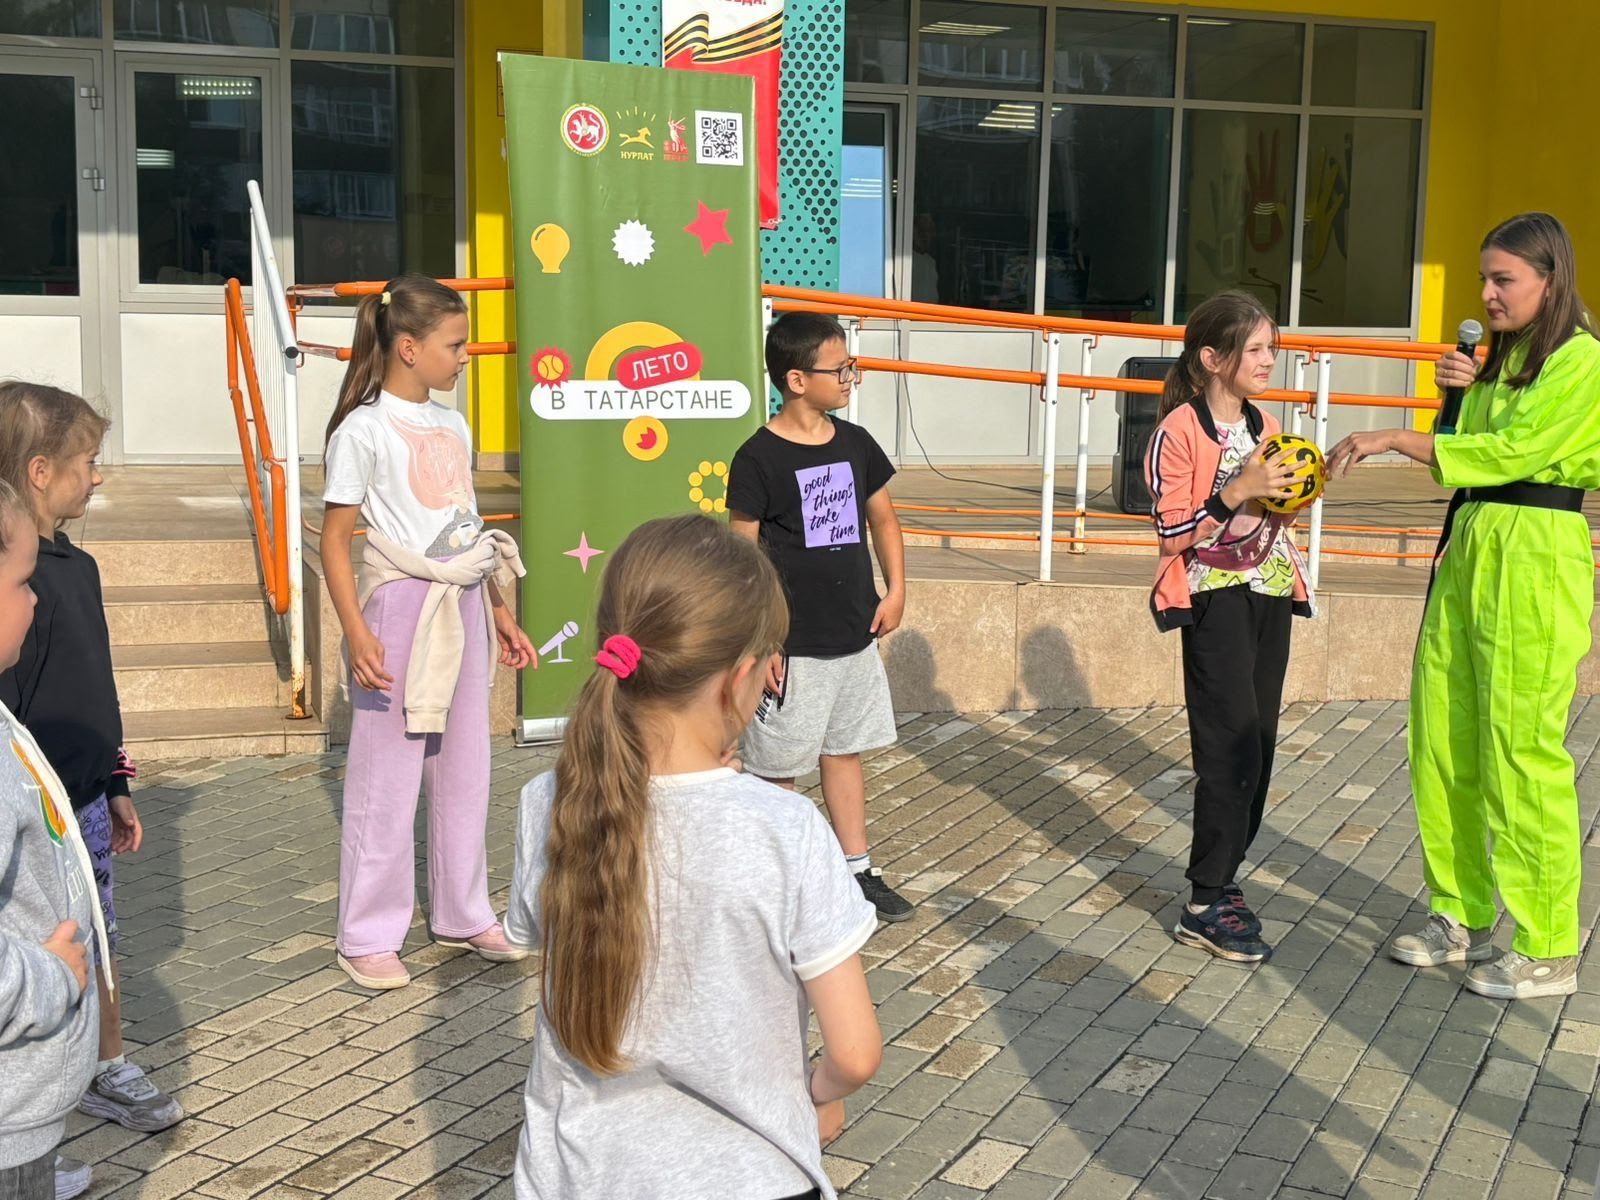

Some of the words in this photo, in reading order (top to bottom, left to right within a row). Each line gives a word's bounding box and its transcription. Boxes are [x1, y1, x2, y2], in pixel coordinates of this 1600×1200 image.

[620, 151, 655, 161] НУРЛАТ
[632, 351, 689, 382] ЛЕТО
[551, 390, 566, 410] В
[584, 390, 733, 410] ТАТАРСТАНЕ
[804, 466, 832, 502] good
[813, 482, 854, 511] things
[810, 508, 840, 531] take
[829, 524, 856, 543] time
